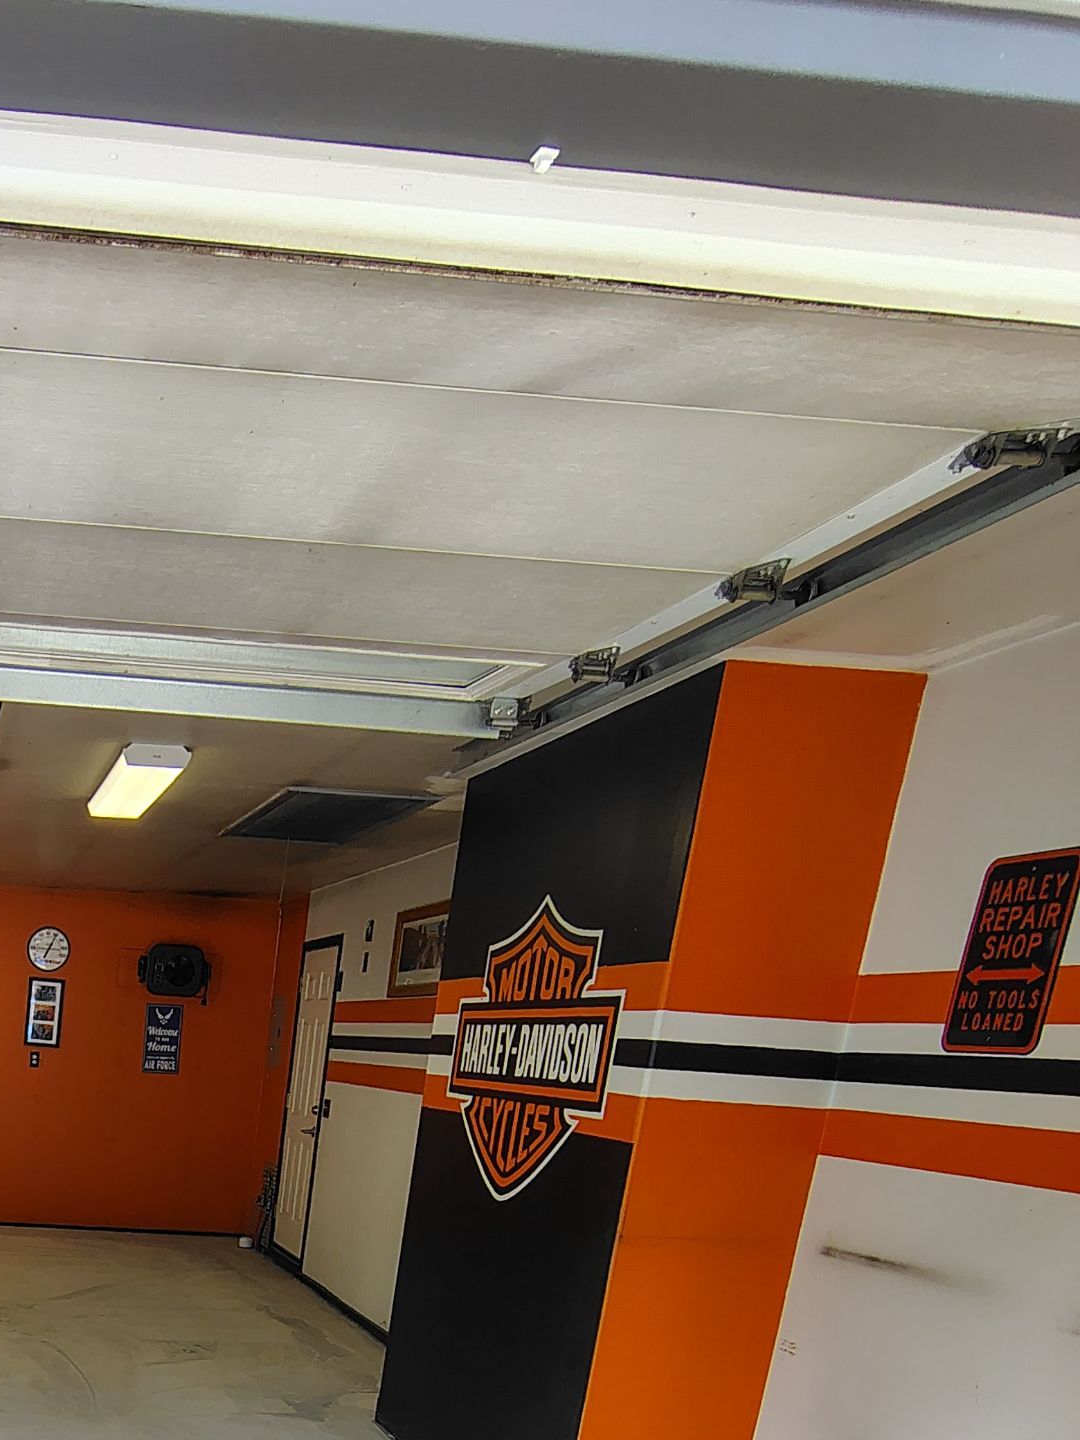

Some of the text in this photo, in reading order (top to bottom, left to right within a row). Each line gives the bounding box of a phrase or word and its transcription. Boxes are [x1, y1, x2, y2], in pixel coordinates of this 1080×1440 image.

[988, 871, 1070, 905] HARLEY
[978, 903, 1061, 933] REPAIR
[982, 932, 1043, 960] SHOP
[498, 933, 576, 1002] MOTOR
[957, 988, 1040, 1009] NO TOOLS
[147, 1025, 179, 1037] Welcome
[960, 1012, 1024, 1032] LOANED
[147, 1041, 177, 1052] Home
[460, 1023, 604, 1084] HARLEY-DAVIDSON
[144, 1060, 176, 1071] AIR FORCE
[478, 1097, 552, 1173] CYCLES
